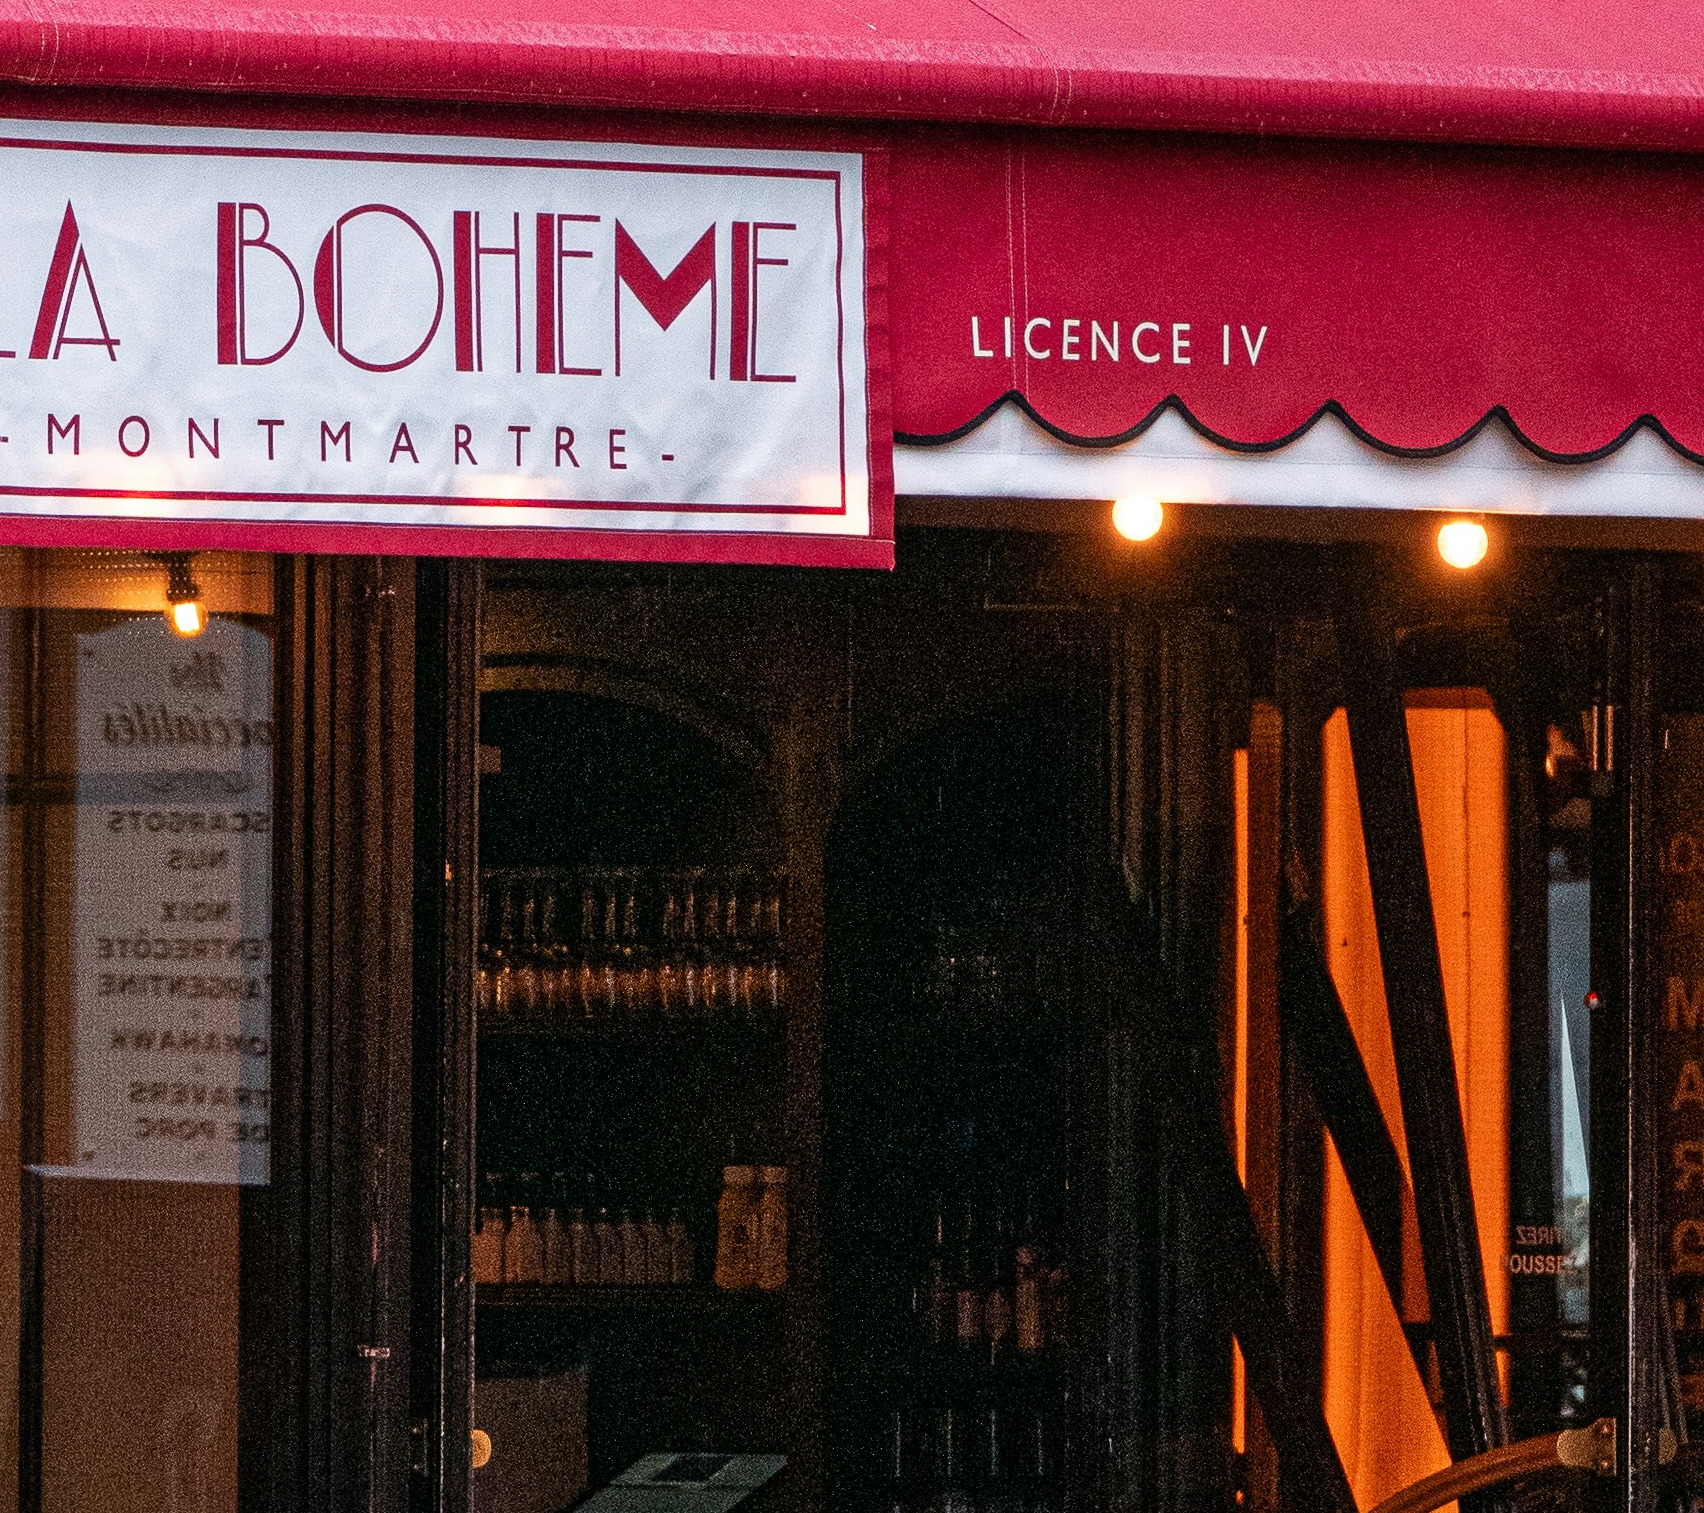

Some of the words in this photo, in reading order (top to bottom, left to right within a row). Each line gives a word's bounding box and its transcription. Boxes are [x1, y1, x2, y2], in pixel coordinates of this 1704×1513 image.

[216, 201, 797, 384] BOHEME
[971, 316, 1191, 364] LICENCE
[1222, 325, 1268, 367] IV
